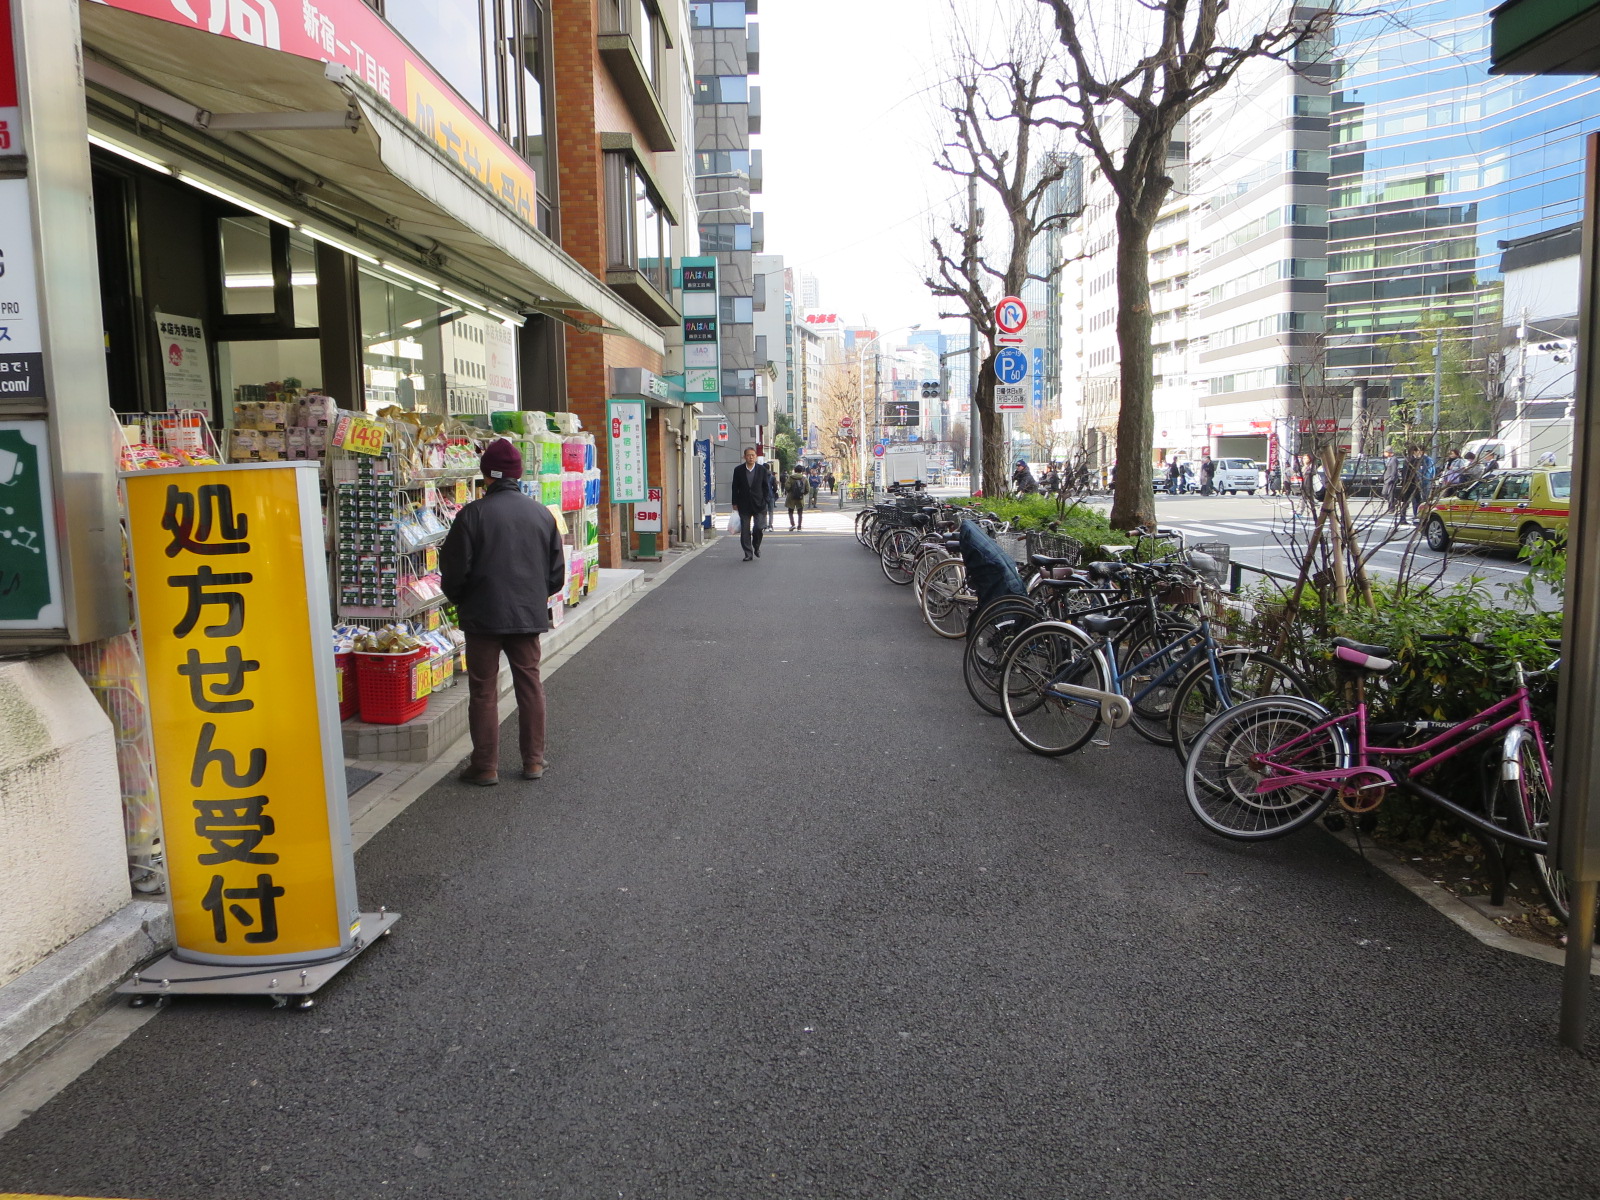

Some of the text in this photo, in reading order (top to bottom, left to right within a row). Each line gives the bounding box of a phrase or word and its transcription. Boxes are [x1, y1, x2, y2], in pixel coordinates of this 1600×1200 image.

[303, 0, 391, 103] 新宿一丁目店
[1, 301, 20, 314] PRO
[0, 361, 29, 372] Bで!
[1002, 357, 1015, 380] P
[1010, 370, 1021, 380] 60
[702, 377, 716, 391] 歯
[350, 426, 382, 449] 148
[623, 424, 633, 497] 新宿すわ歯科
[161, 483, 285, 945] 処方せん受付
